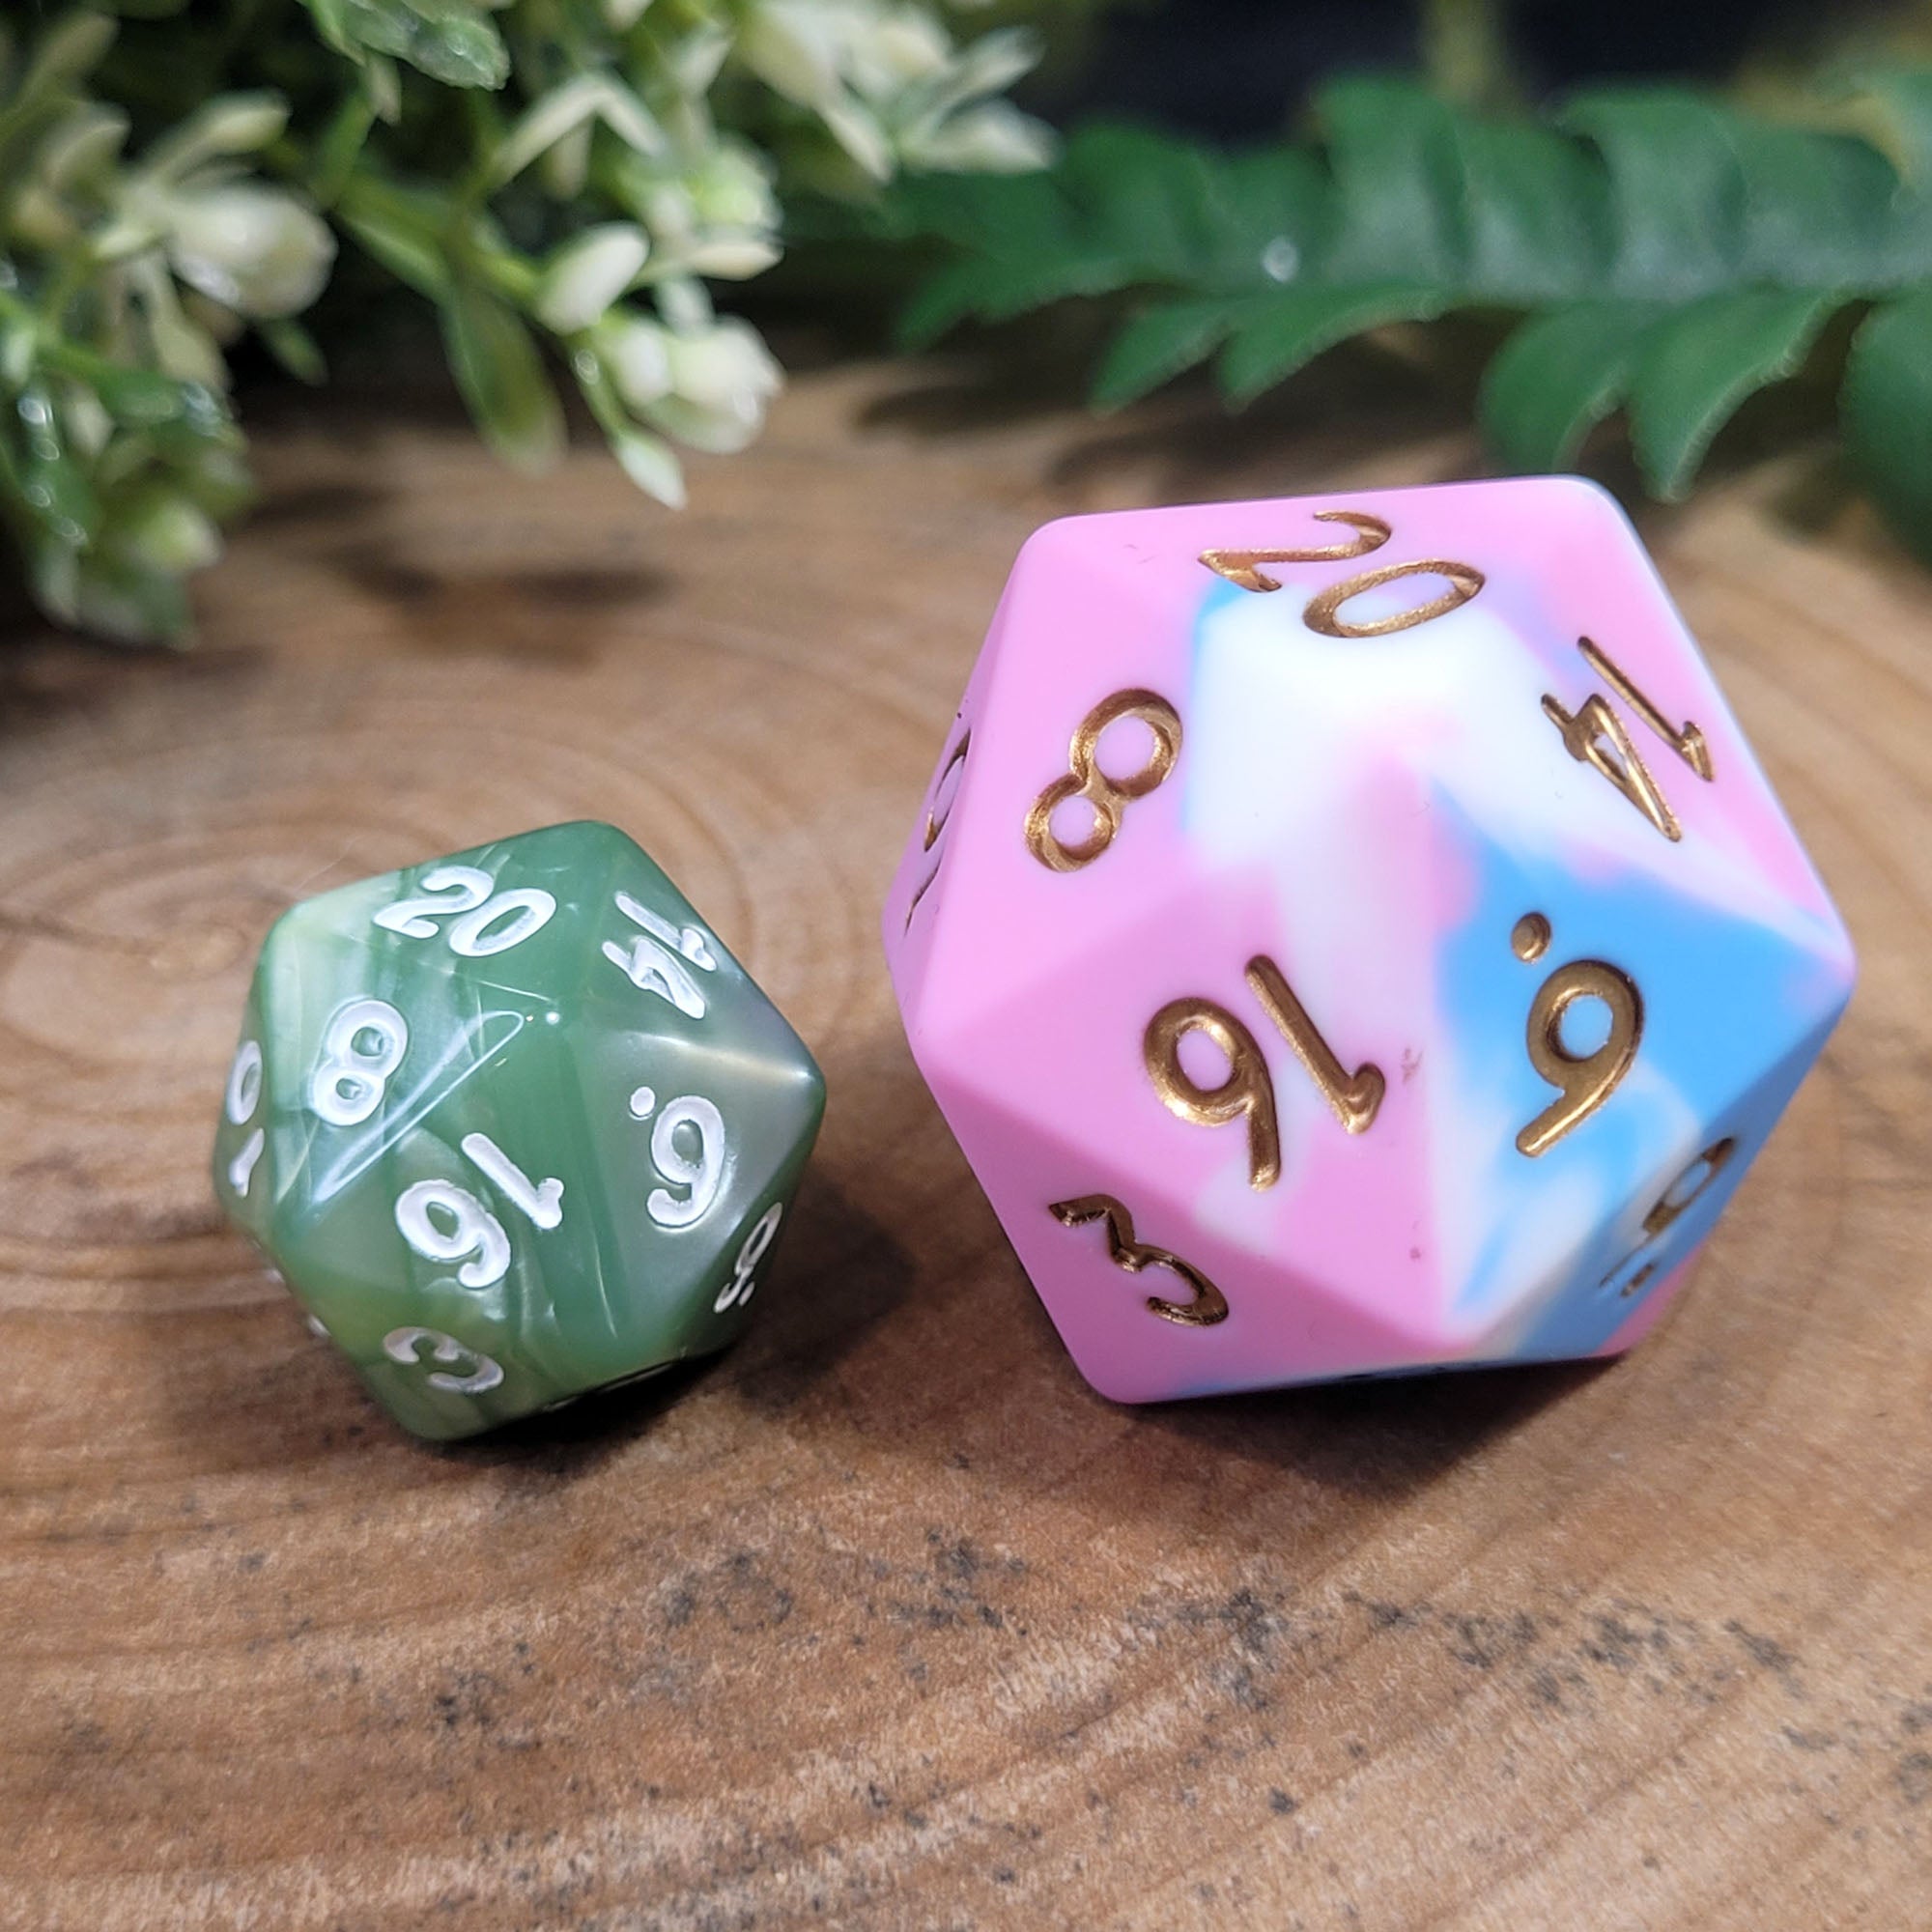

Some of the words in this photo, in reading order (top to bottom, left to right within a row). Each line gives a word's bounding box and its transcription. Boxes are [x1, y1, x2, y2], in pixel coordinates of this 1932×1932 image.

[1197, 509, 1487, 639] 20
[1024, 687, 1183, 873] 8
[1541, 635, 1715, 843] 14
[373, 866, 557, 957] 20
[601, 891, 718, 1020] 14
[309, 998, 410, 1127] 8
[1142, 952, 1387, 1192] 16
[394, 1131, 565, 1290] 16
[1048, 1193, 1229, 1327] 3
[382, 1325, 505, 1394] 3
